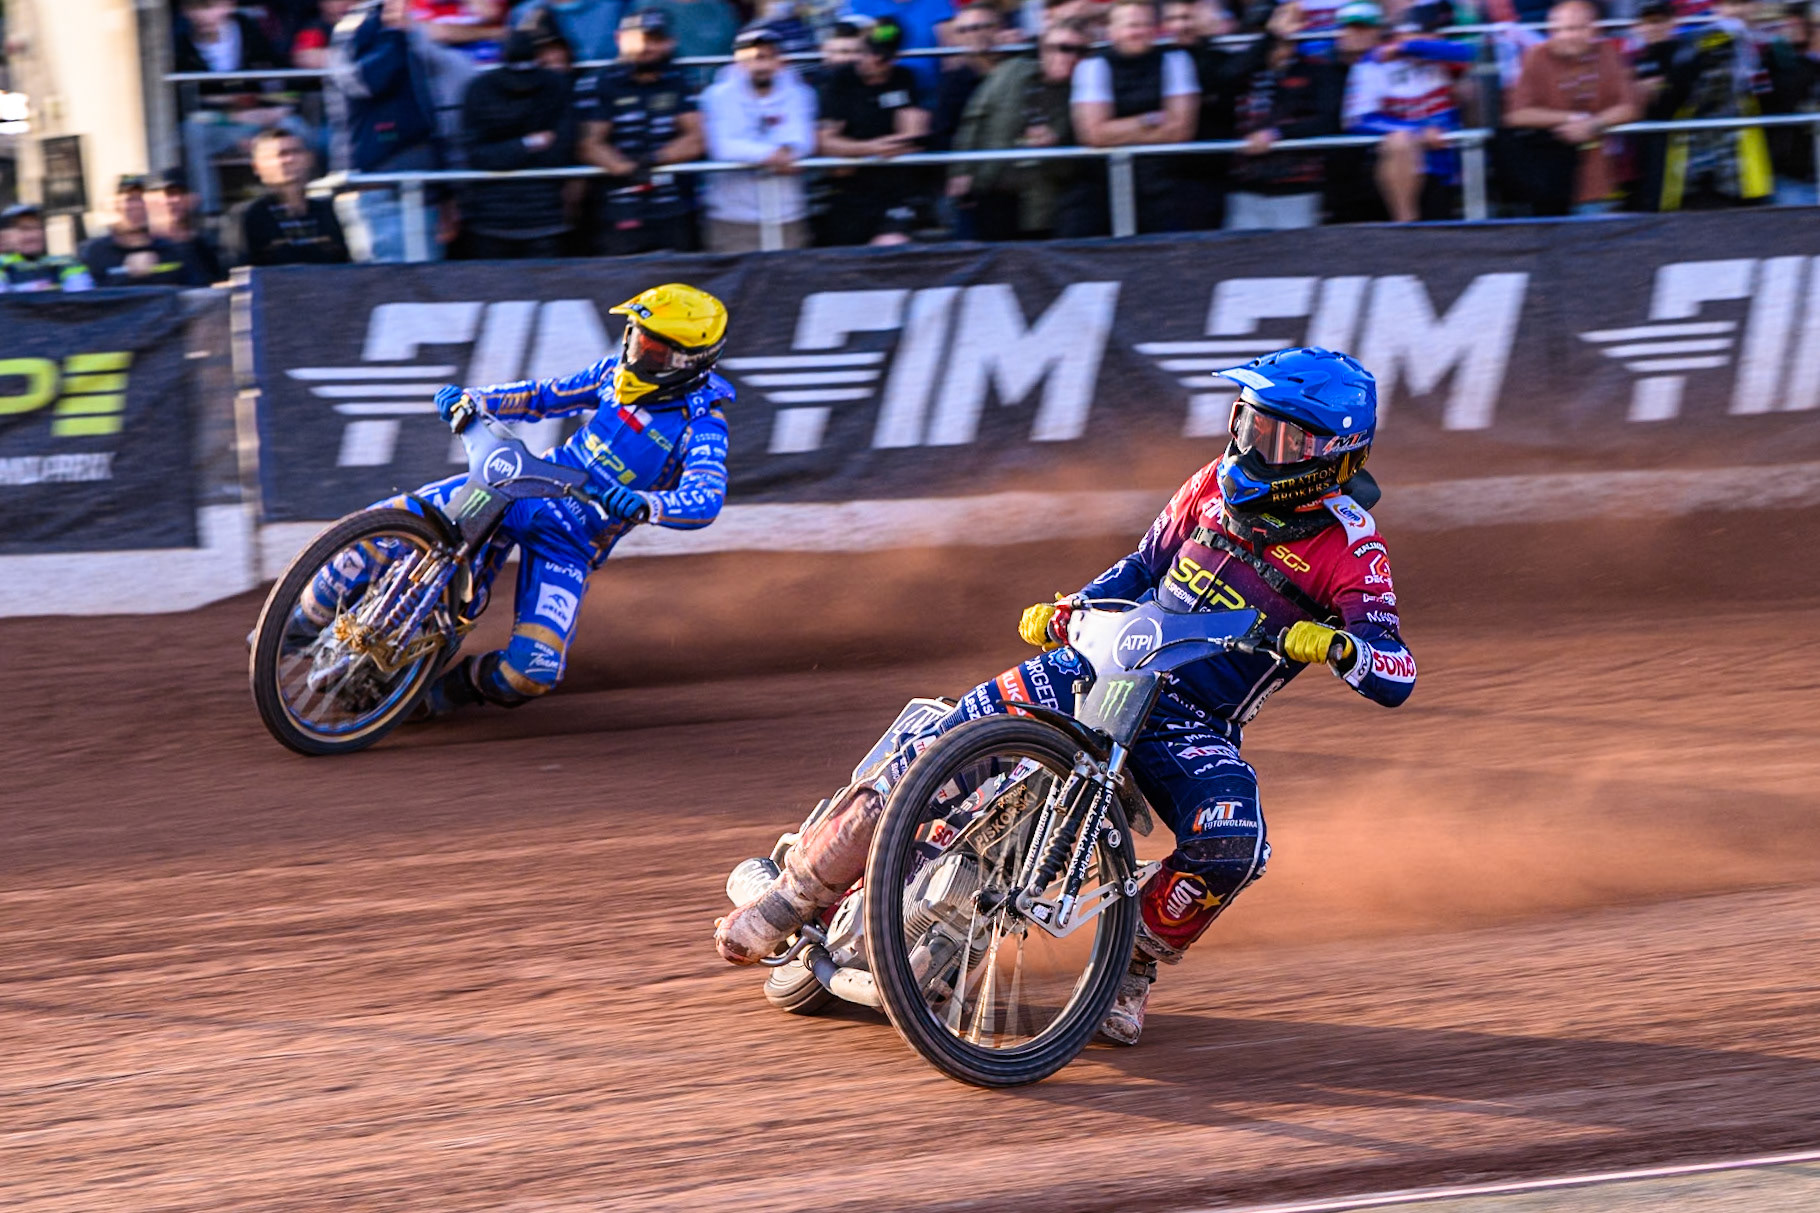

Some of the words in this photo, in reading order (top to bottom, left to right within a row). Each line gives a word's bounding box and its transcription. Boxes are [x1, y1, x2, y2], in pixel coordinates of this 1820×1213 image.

[1578, 256, 1820, 424] FI
[717, 281, 1122, 454] FIM
[489, 457, 515, 477] ATPI
[1270, 465, 1337, 492] STRATTON
[1272, 482, 1330, 503] BROKERS
[1339, 507, 1361, 522] LOTTO
[1270, 545, 1311, 573] SGP
[1168, 583, 1198, 612] SPEEDWA
[1169, 557, 1247, 611] SGP
[1118, 634, 1153, 661] ATPI
